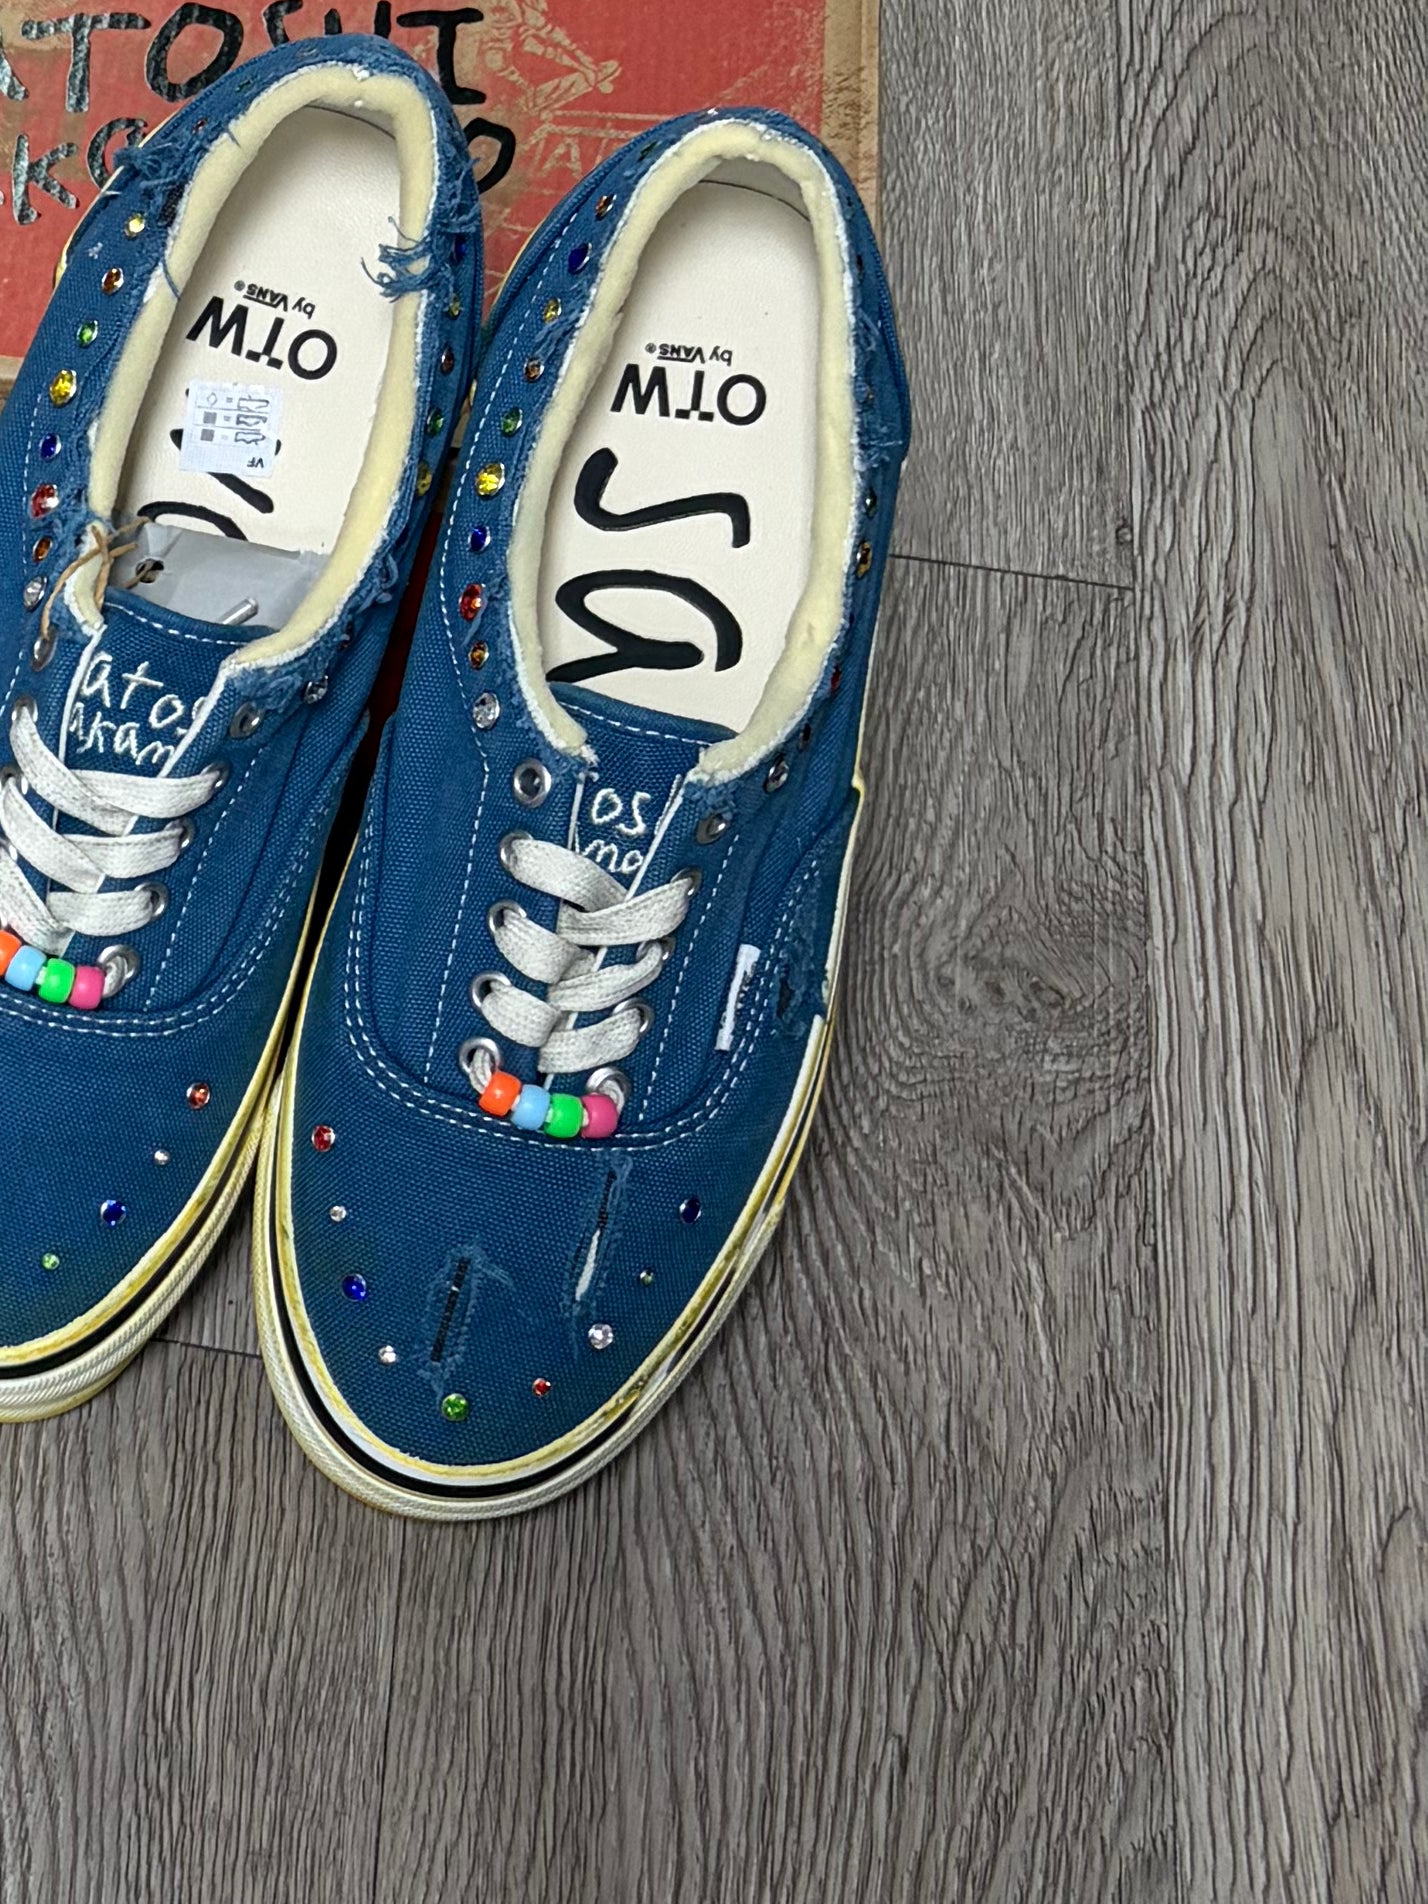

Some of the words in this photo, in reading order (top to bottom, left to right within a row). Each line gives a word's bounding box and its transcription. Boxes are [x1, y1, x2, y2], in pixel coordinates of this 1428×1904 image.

[291, 296, 316, 320] by
[185, 296, 338, 380] OTW
[708, 345, 733, 367] by
[610, 362, 767, 426] OTW
